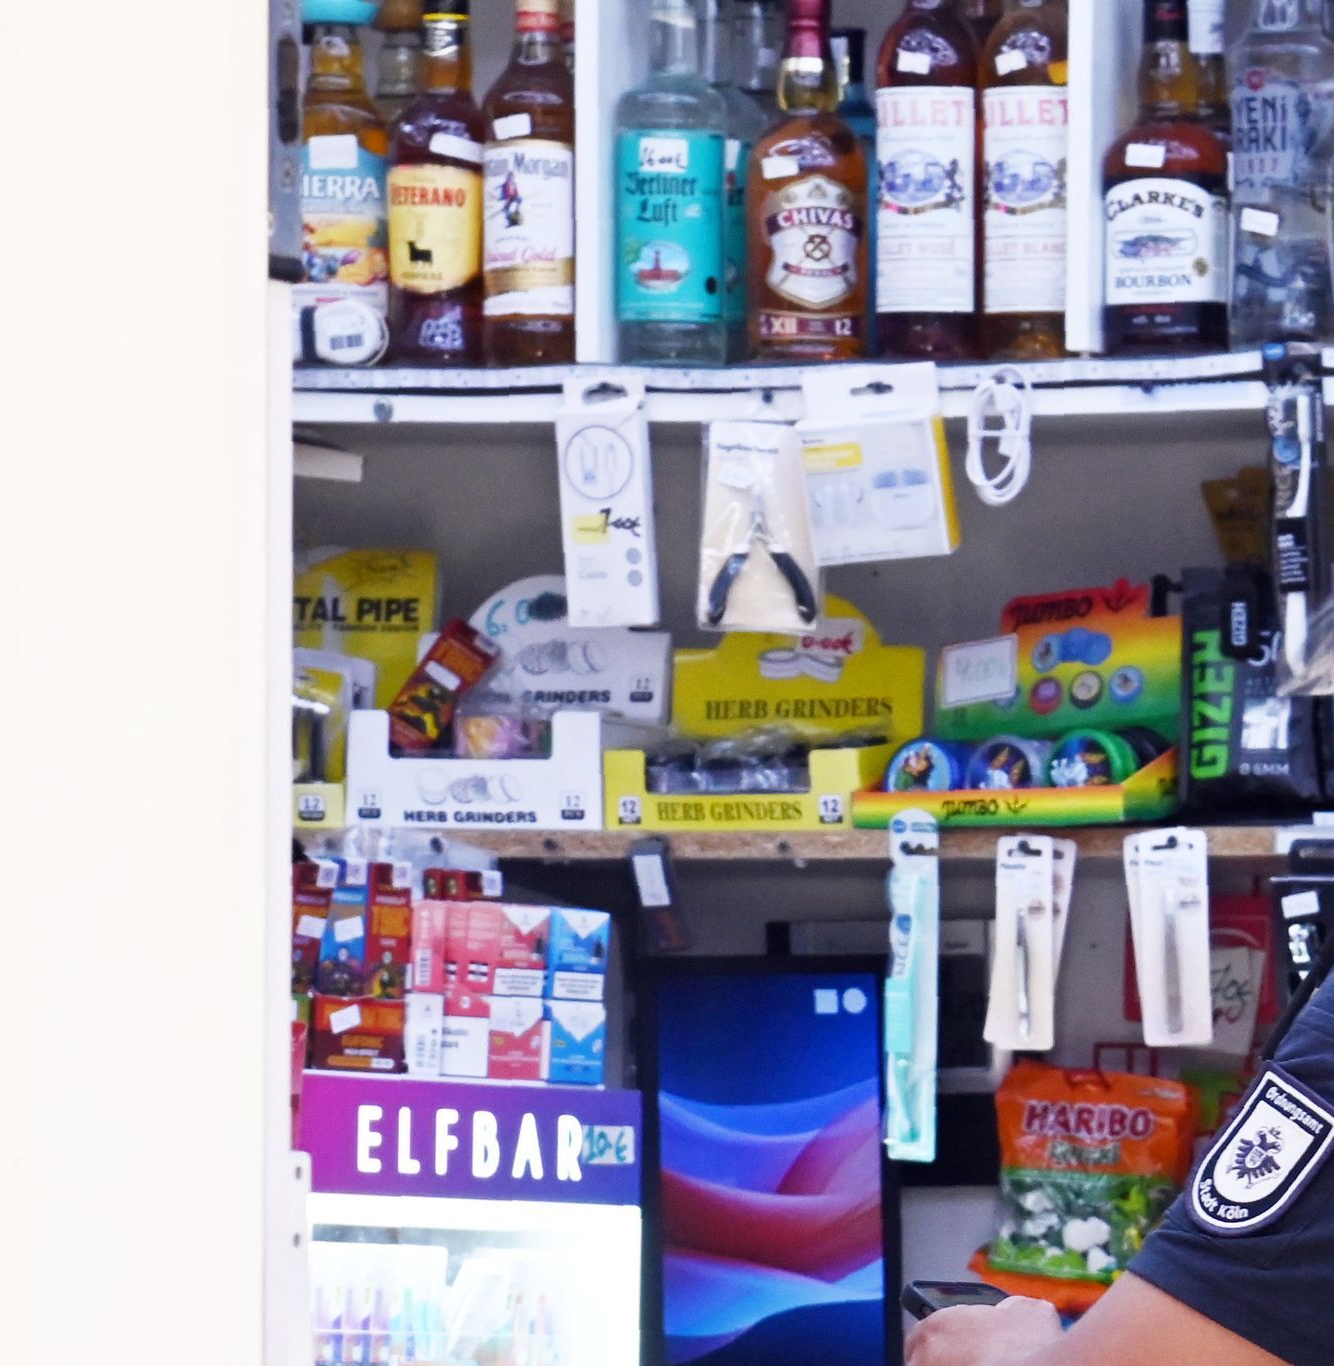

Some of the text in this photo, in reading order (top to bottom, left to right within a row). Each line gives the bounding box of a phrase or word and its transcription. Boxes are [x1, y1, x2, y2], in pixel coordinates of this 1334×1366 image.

[300, 174, 380, 199] IERRA
[776, 207, 854, 229] CHIVAS
[835, 316, 852, 335] 12
[357, 597, 420, 622] PIPE
[705, 697, 894, 720] HERB GRINDERS
[404, 810, 538, 824] HERB GRINDERS
[657, 800, 803, 821] HERB GRINDERS
[1024, 1100, 1155, 1139] HARIBO
[1265, 1085, 1324, 1135] Ordnungsamt
[357, 1104, 582, 1182] ELFBAR
[1198, 1178, 1249, 1221] Stadt Köln
